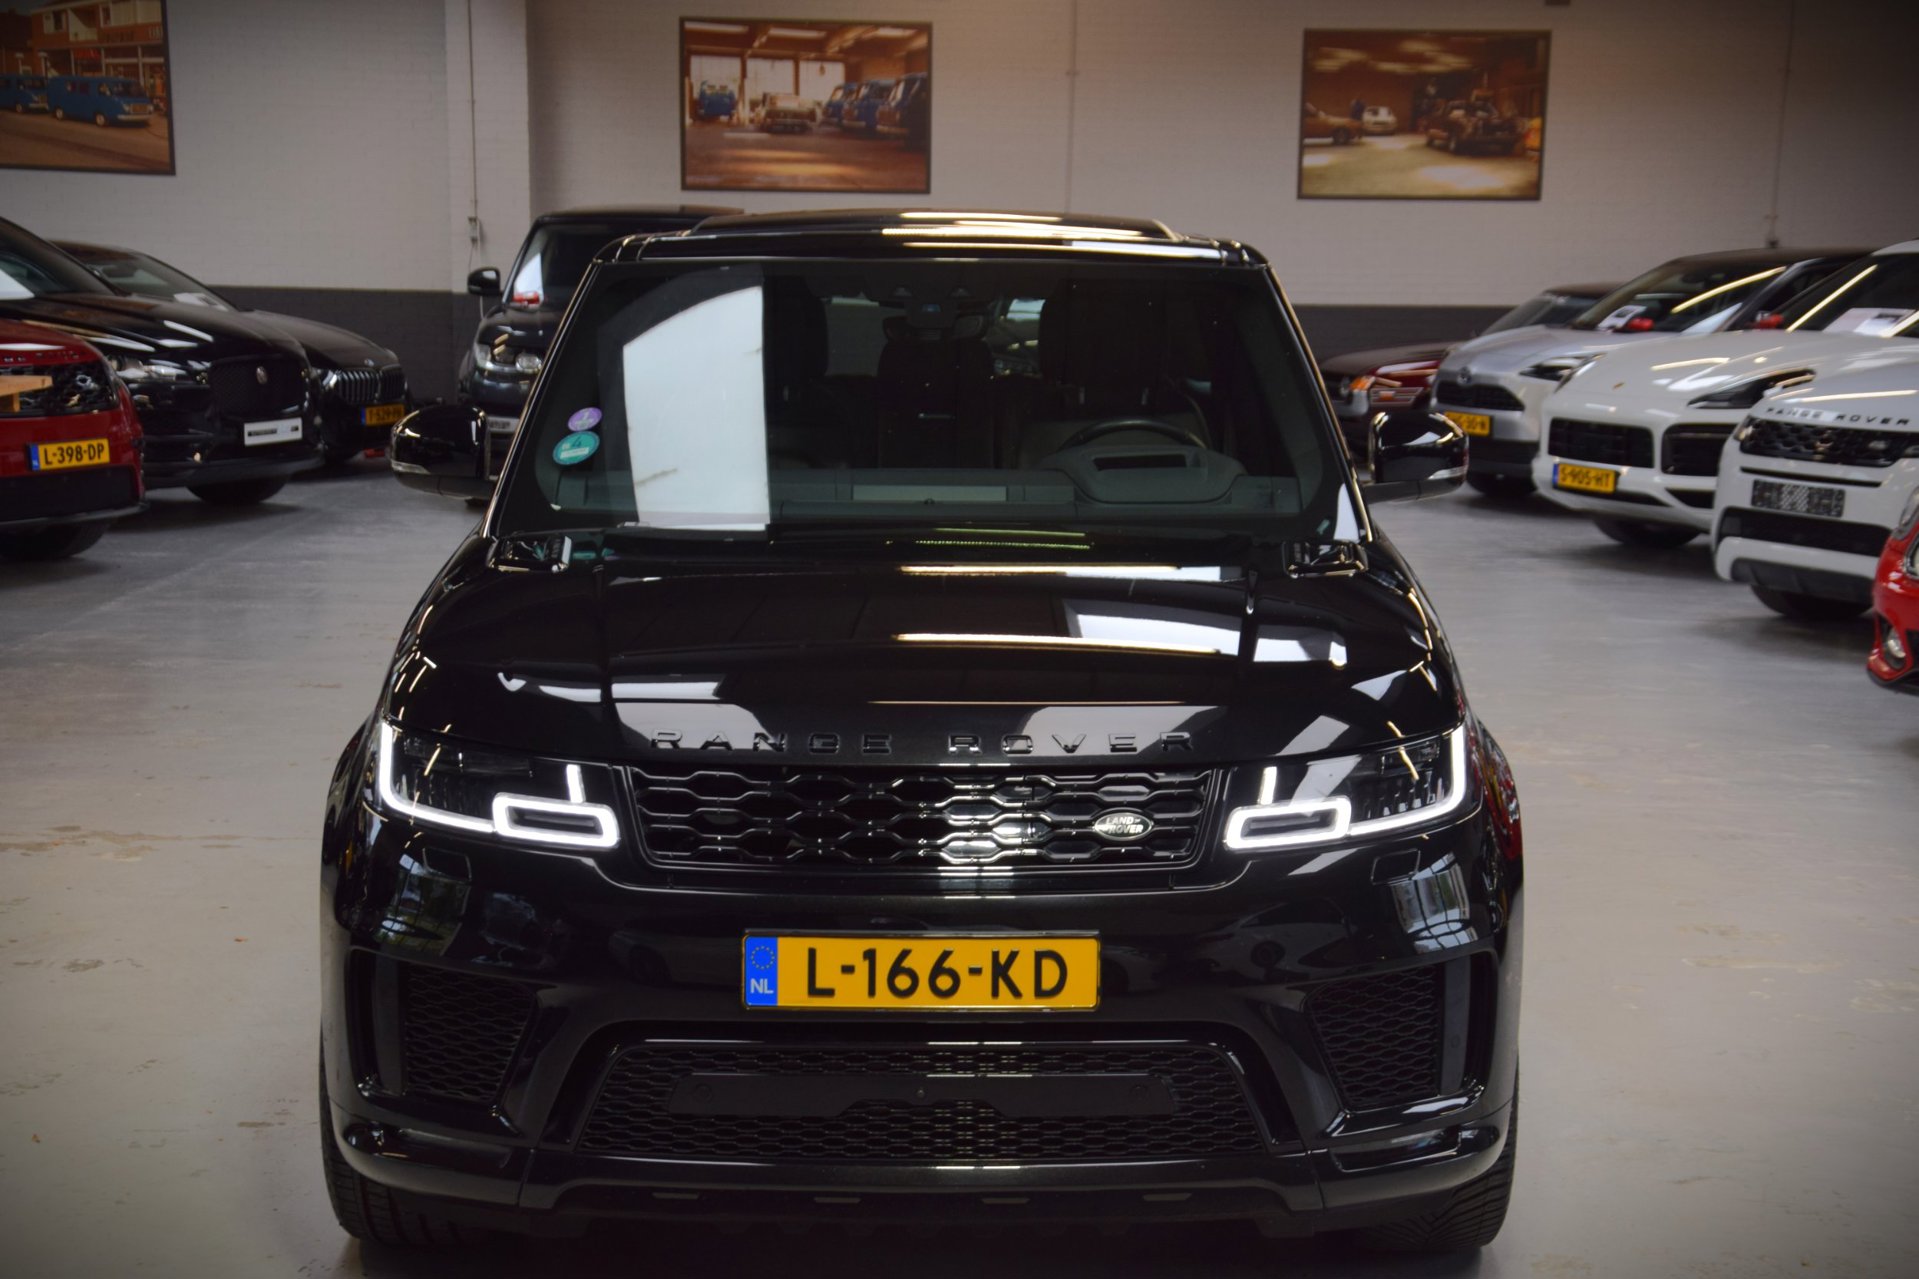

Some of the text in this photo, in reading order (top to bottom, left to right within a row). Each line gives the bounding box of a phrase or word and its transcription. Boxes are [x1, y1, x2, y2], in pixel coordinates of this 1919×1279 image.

[1766, 406, 1911, 426] RANGE ROVER
[43, 442, 105, 465] L-398-DP
[650, 728, 1192, 755] RANGE ROVER
[1107, 824, 1144, 834] ROVER
[750, 947, 1068, 999] NL L-166-KD
